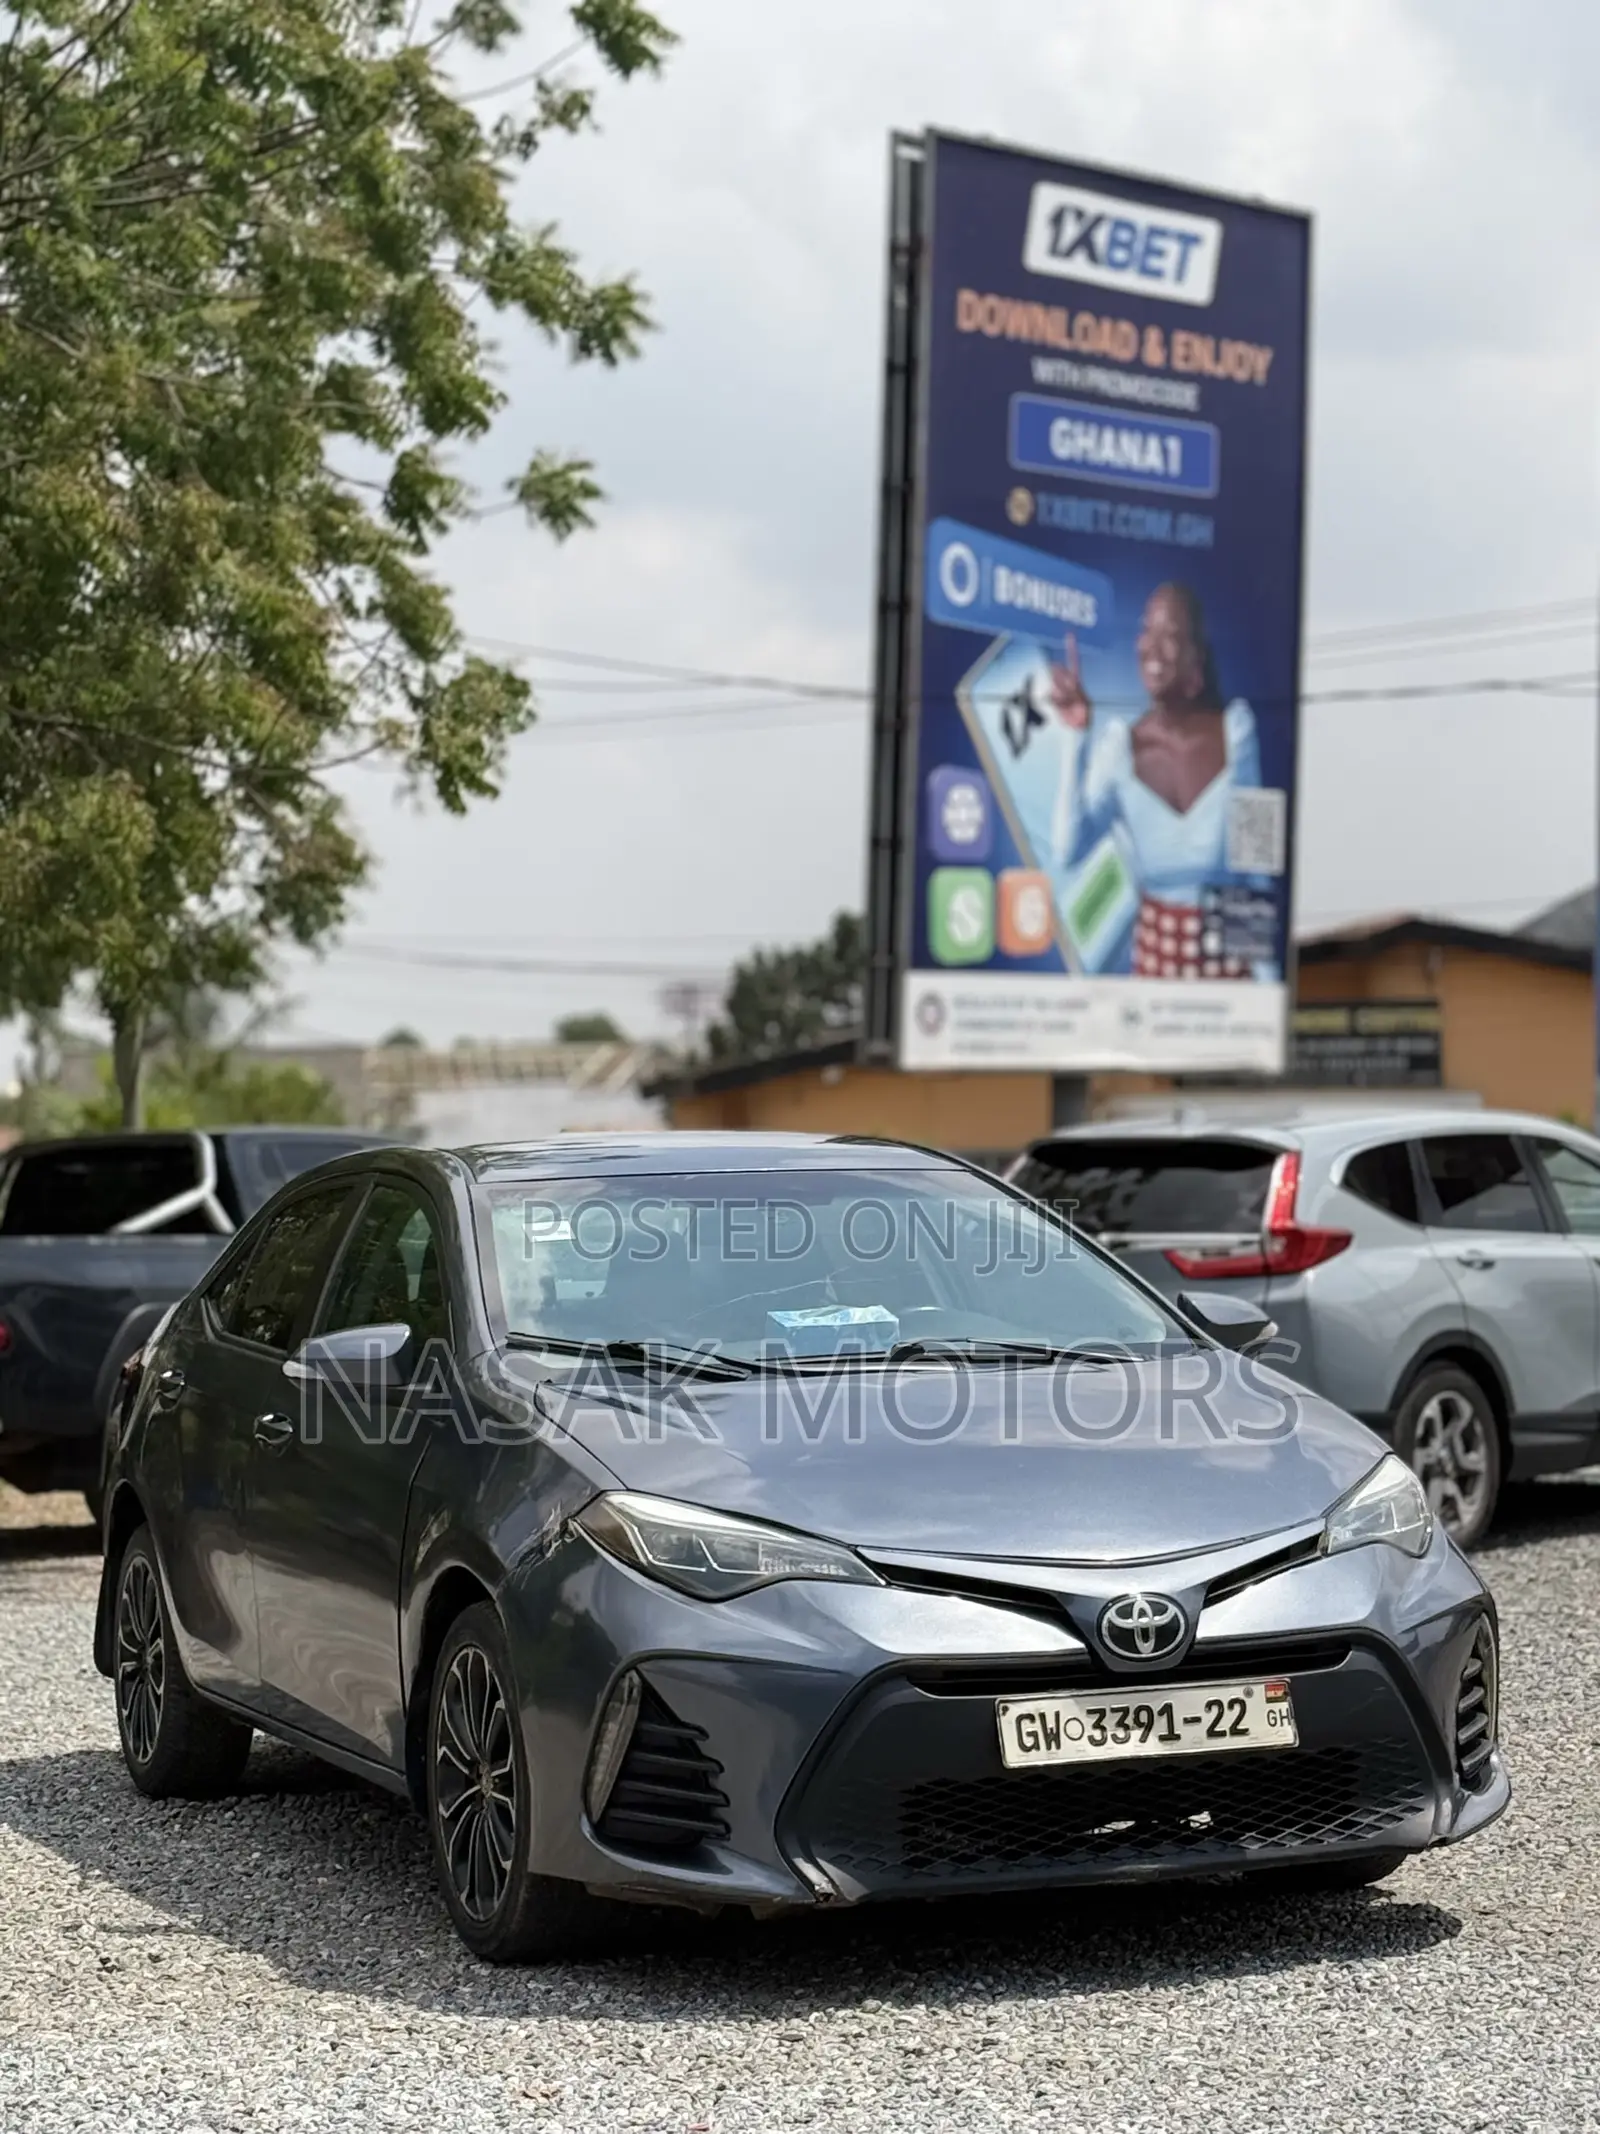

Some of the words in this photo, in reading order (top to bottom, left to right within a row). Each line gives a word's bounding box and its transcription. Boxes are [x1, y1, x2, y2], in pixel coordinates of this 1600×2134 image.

[1045, 204, 1205, 285] 1XBET
[956, 287, 1138, 363] DOWNLOAD
[1141, 324, 1167, 368] &
[1170, 328, 1274, 386] ENJOY
[1049, 416, 1182, 478] GHANA1
[994, 565, 1098, 629] BONUSES
[1085, 1697, 1250, 1747] 3391-22
[1265, 1706, 1292, 1728] GH
